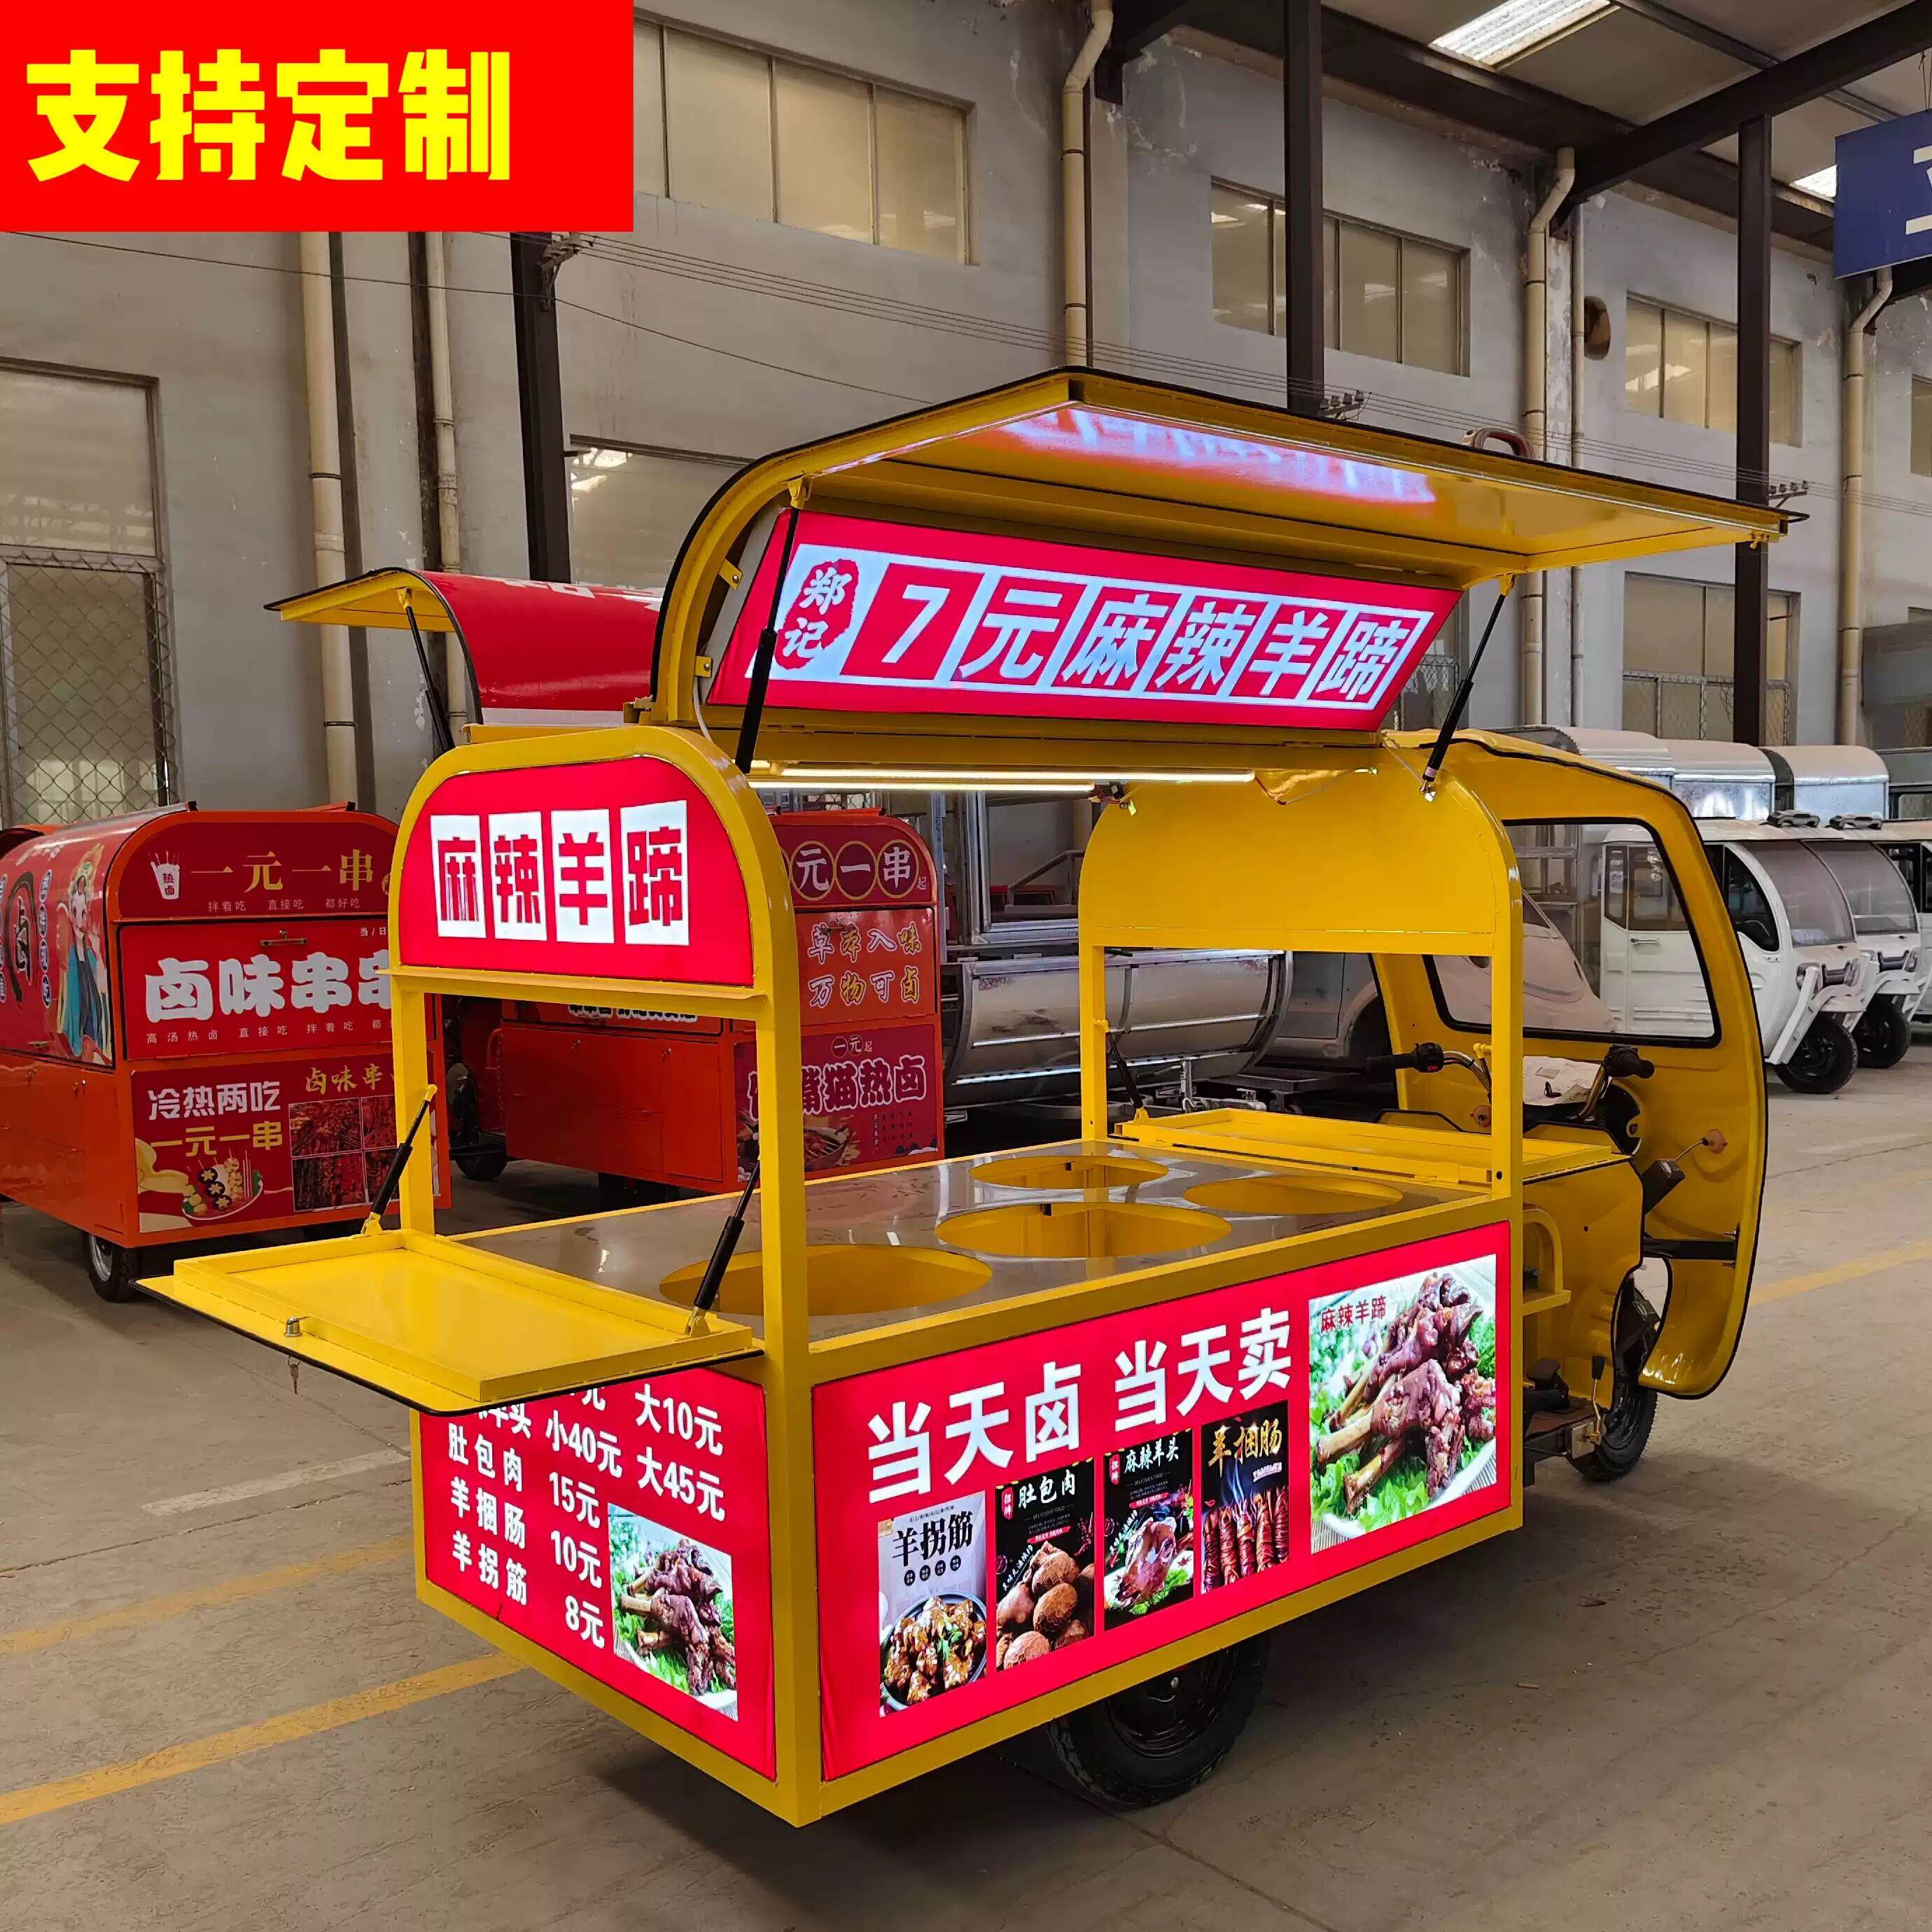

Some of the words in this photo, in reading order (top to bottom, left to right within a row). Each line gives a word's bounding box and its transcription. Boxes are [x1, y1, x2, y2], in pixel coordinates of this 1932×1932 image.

[782, 568, 845, 657] 郑记
[882, 585, 1404, 700] 7元麻辣羊蹄
[190, 848, 374, 892] 一元一串
[437, 826, 683, 926] 麻辣羊蹄
[208, 900, 246, 912] 拌着吃
[267, 899, 304, 911] 直接吃
[808, 965, 920, 1009] 万物可卤
[146, 1030, 218, 1045] 高汤热卤
[239, 1025, 288, 1039] 直接吃
[307, 1021, 354, 1034] 拌着吃
[148, 1080, 281, 1120] 冷热两吃
[150, 1121, 283, 1156] 一元一串
[1320, 1296, 1387, 1333] 麻辣羊蹄
[635, 1383, 723, 1456] 大10元
[868, 1362, 1082, 1504] 当天卤
[1115, 1308, 1291, 1432] 当天卖
[449, 1422, 522, 1492] 肚包肉
[550, 1472, 600, 1529] 15元
[545, 1409, 623, 1478] 小40元
[637, 1446, 725, 1522] 大45元
[1018, 1469, 1076, 1509] 肚包肉
[551, 1530, 602, 1588] 10元
[892, 1511, 973, 1567] 羊拐筋
[452, 1531, 527, 1606] 羊拐筋
[566, 1595, 605, 1648] 8元
